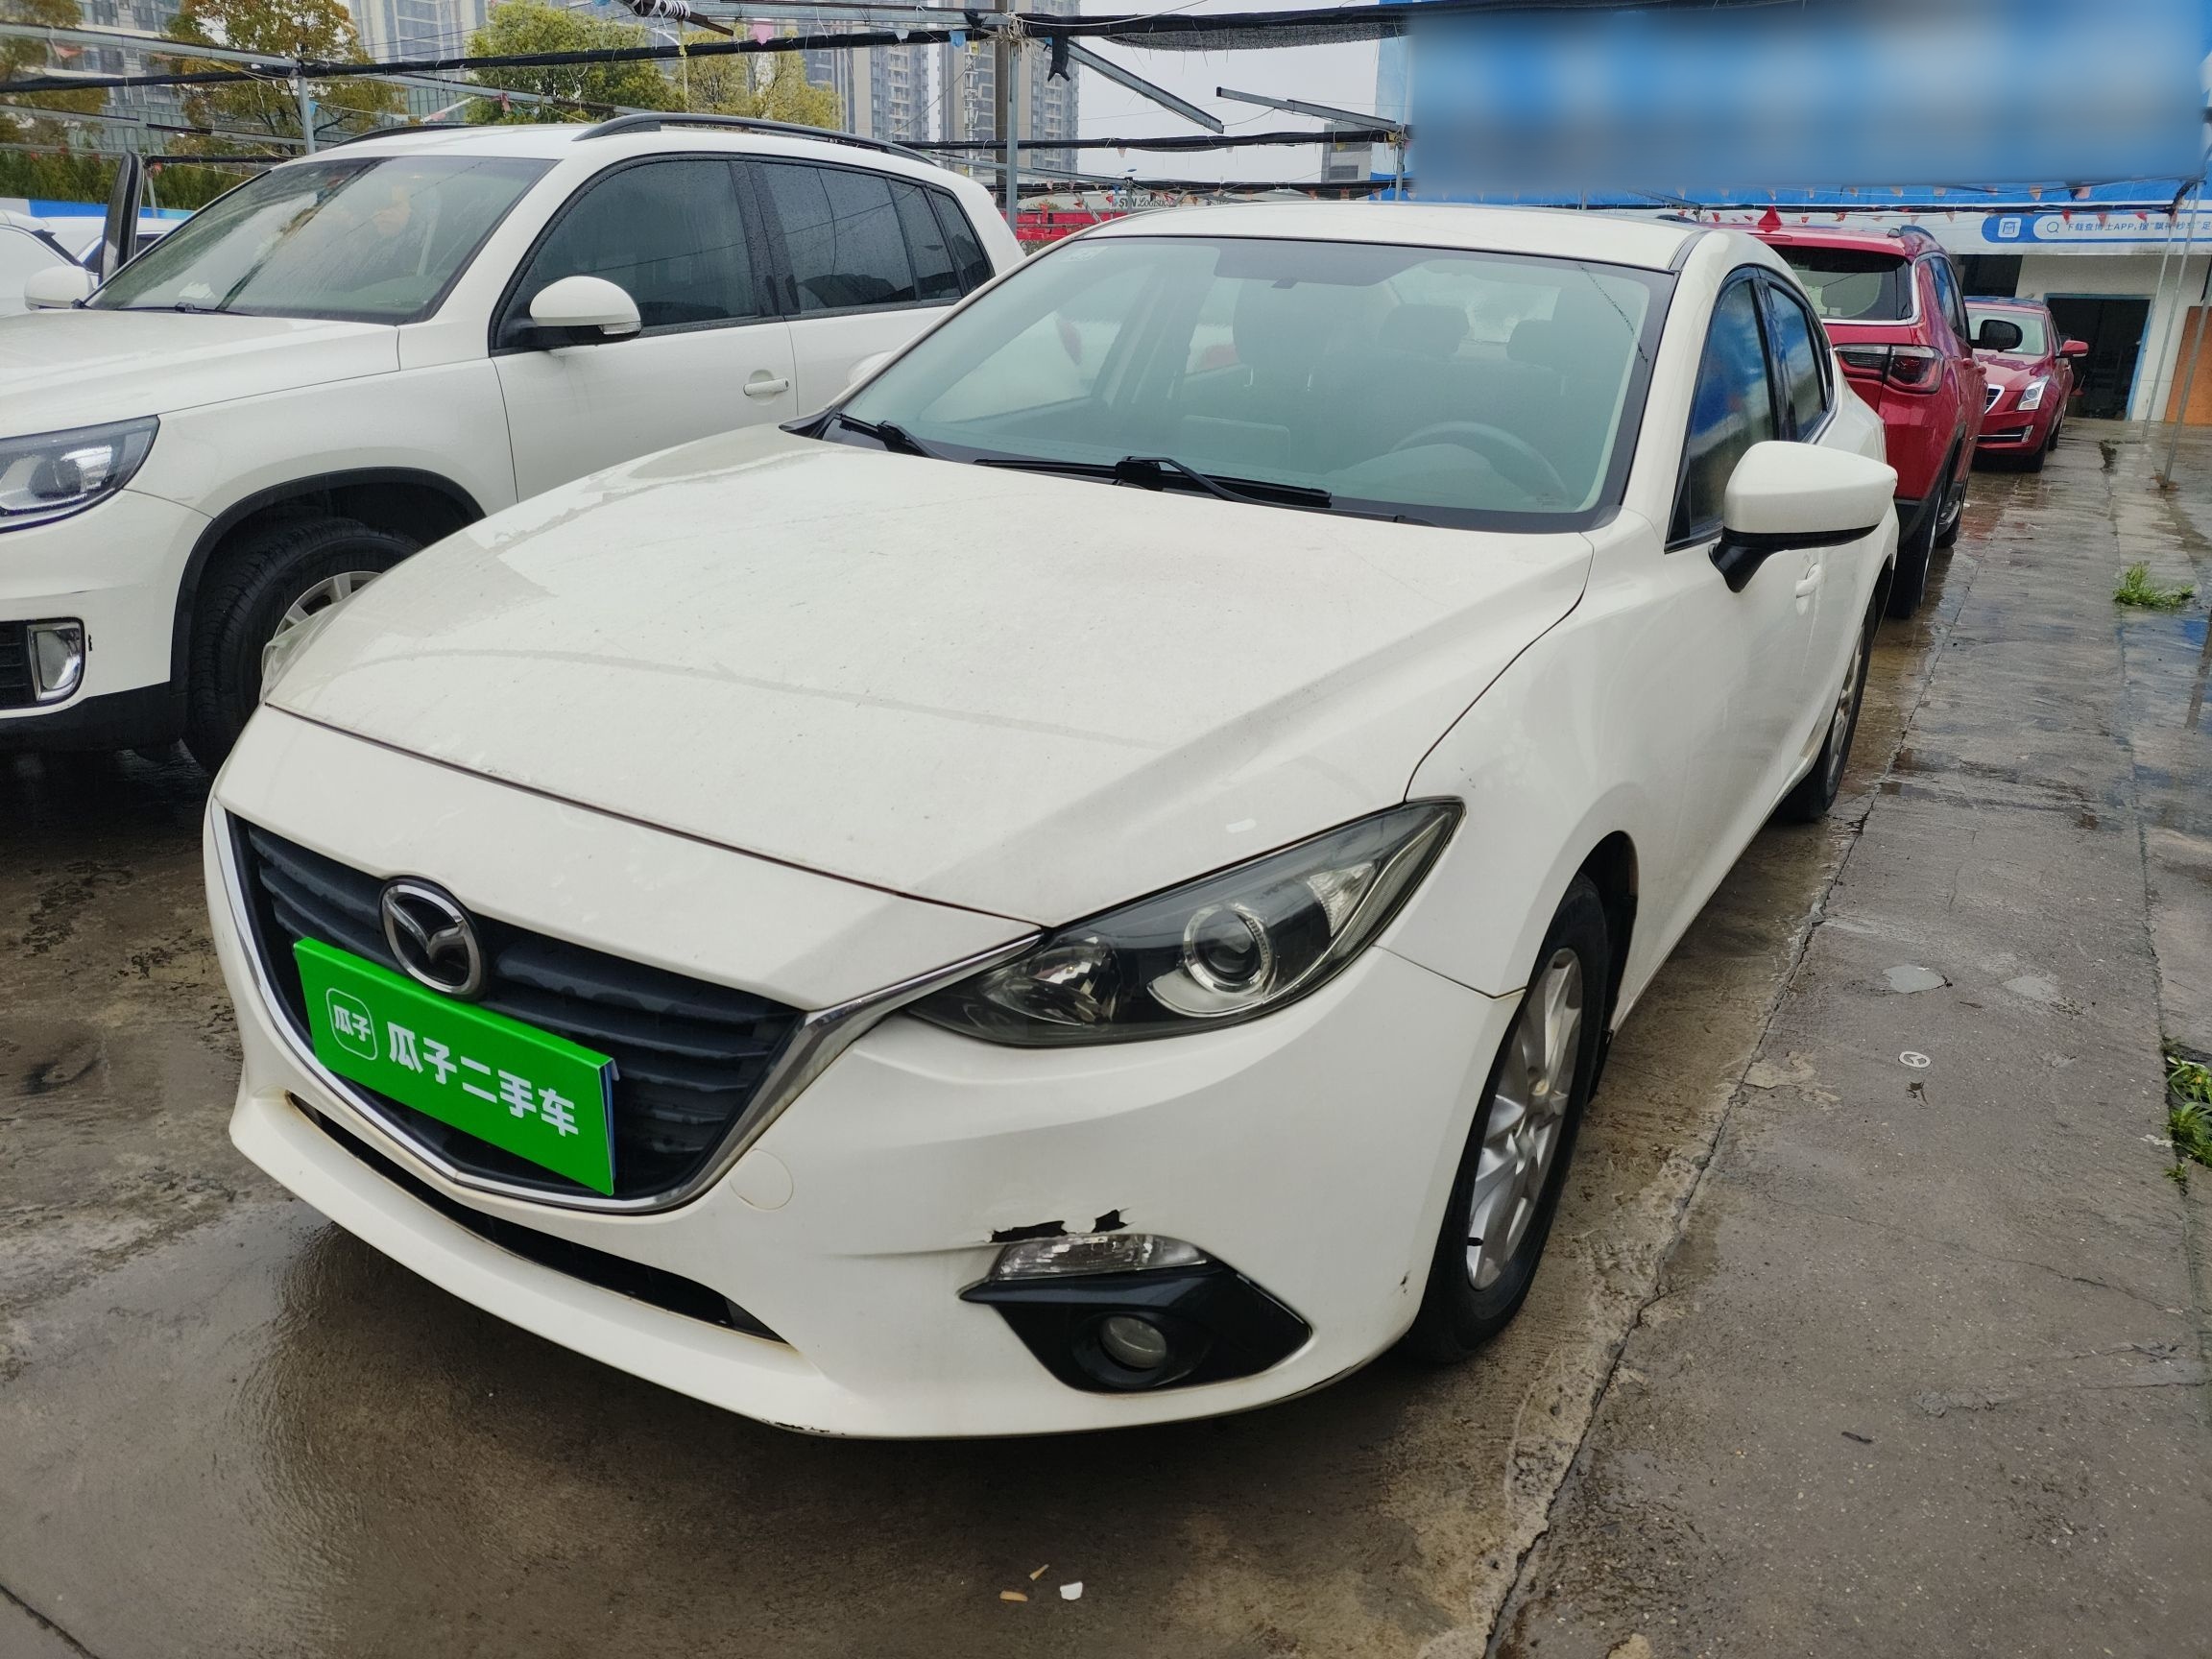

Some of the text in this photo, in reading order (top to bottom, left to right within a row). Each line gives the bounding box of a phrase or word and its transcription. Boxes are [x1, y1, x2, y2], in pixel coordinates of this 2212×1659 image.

[333, 1004, 372, 1042] 瓜子
[387, 1022, 579, 1137] 瓜子二手车
